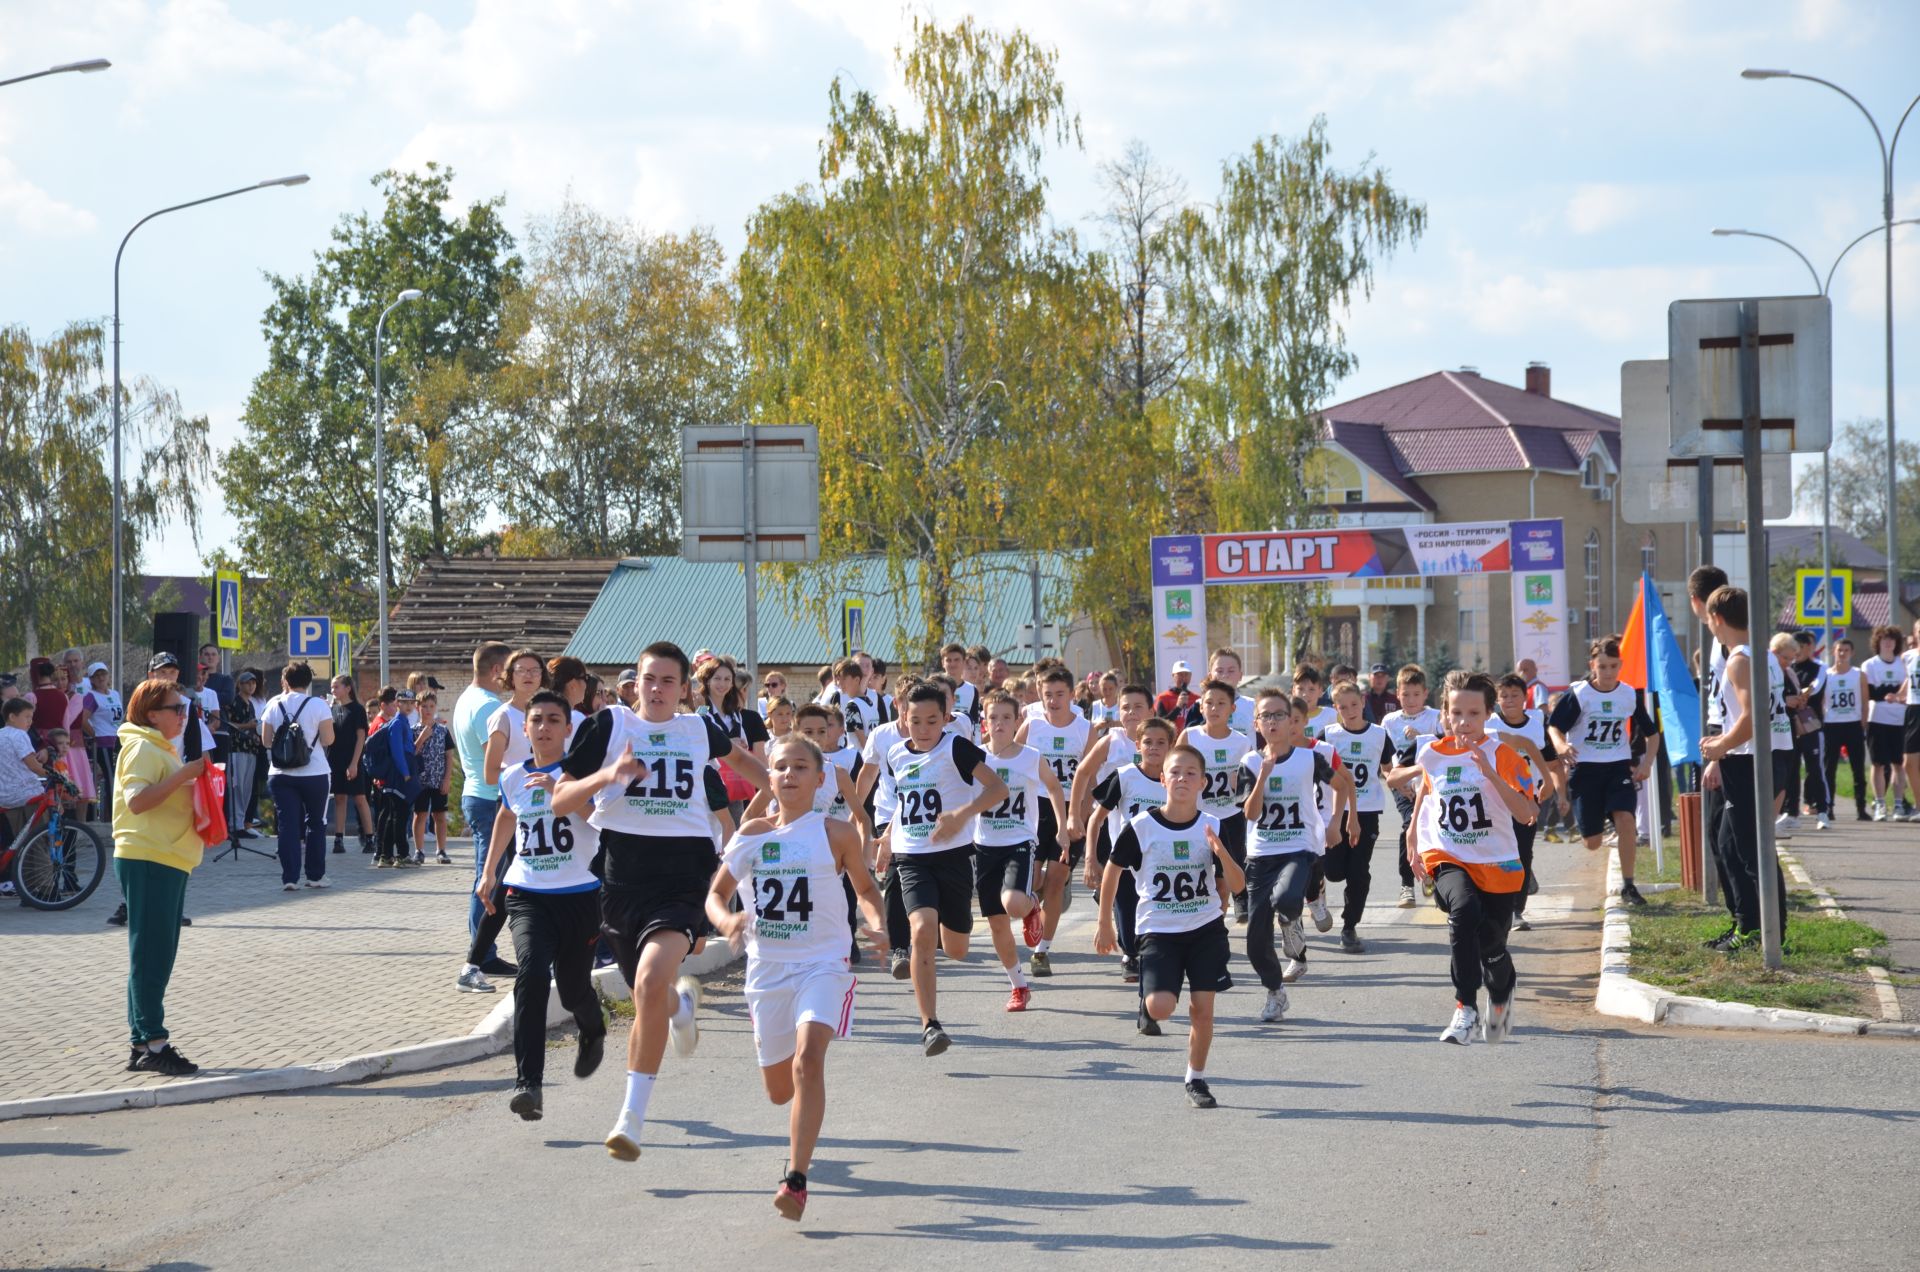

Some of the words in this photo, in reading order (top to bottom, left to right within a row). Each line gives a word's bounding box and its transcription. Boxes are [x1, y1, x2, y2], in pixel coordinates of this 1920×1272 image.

[1414, 530, 1449, 538] «РОССИЯ
[1456, 527, 1506, 537] ТЕРРИТОРИЯ
[1419, 540, 1433, 549] БЕЗ
[1435, 539, 1491, 548] НАРКОТИКОВ»
[1217, 536, 1339, 574] СТАРТ
[300, 621, 322, 653] P
[1831, 691, 1855, 708] 180
[1584, 720, 1622, 742] 176
[624, 757, 694, 800] 215
[1046, 758, 1078, 782] 13
[628, 799, 654, 807] СПОРТ
[660, 800, 689, 809] НОРМА
[644, 807, 676, 816] ЖИЗНИ
[1438, 792, 1493, 832] 261
[1257, 802, 1306, 830] 221
[519, 815, 575, 857] 216
[532, 862, 559, 872] ЖИЗНИ
[544, 855, 572, 864] НОРМА
[1151, 869, 1210, 902] 264
[760, 929, 791, 940] ЖИЗНИ
[775, 923, 808, 932] НОРМА
